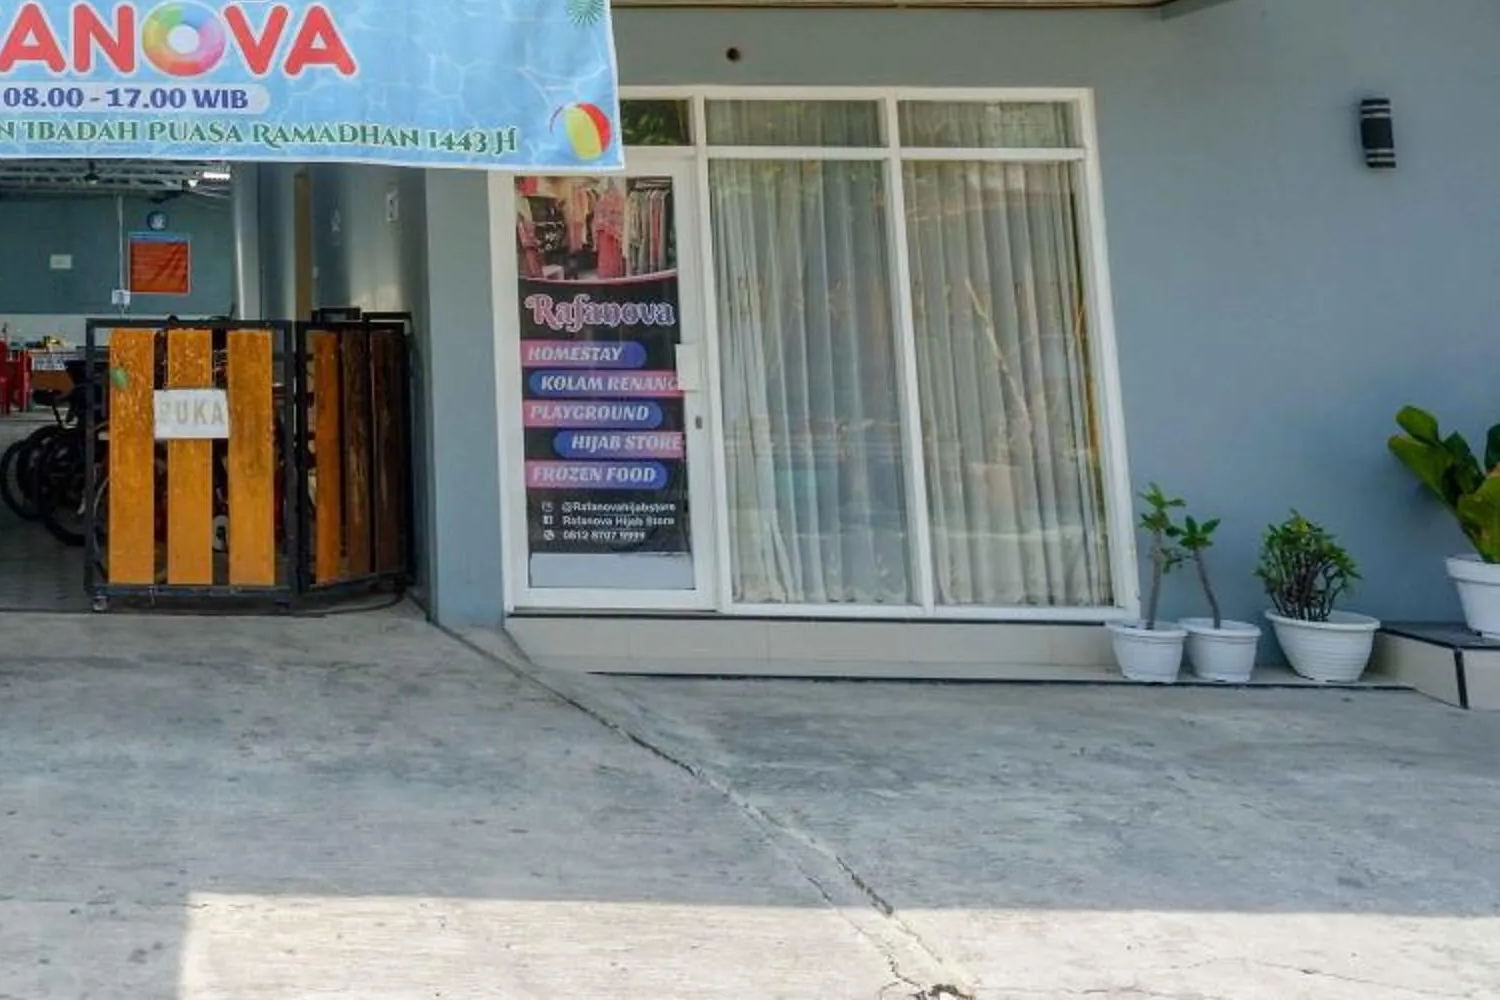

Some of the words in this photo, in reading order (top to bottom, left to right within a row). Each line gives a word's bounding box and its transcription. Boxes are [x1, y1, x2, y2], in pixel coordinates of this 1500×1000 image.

[3, 87, 84, 109] 08.00
[106, 89, 186, 109] 17.00
[192, 89, 249, 110] WIB
[22, 121, 138, 142] IBADAH
[148, 122, 244, 142] PUASA
[250, 123, 420, 149] RAMADHAN
[428, 131, 487, 152] 1443
[529, 346, 622, 361] HOMESTAY
[541, 375, 603, 391] KOLAM
[531, 405, 649, 421] PLAYGROUND
[571, 435, 621, 452] HIJAB
[624, 434, 682, 450] STORE
[532, 468, 601, 482] FROZEN
[606, 467, 656, 482] FOOD
